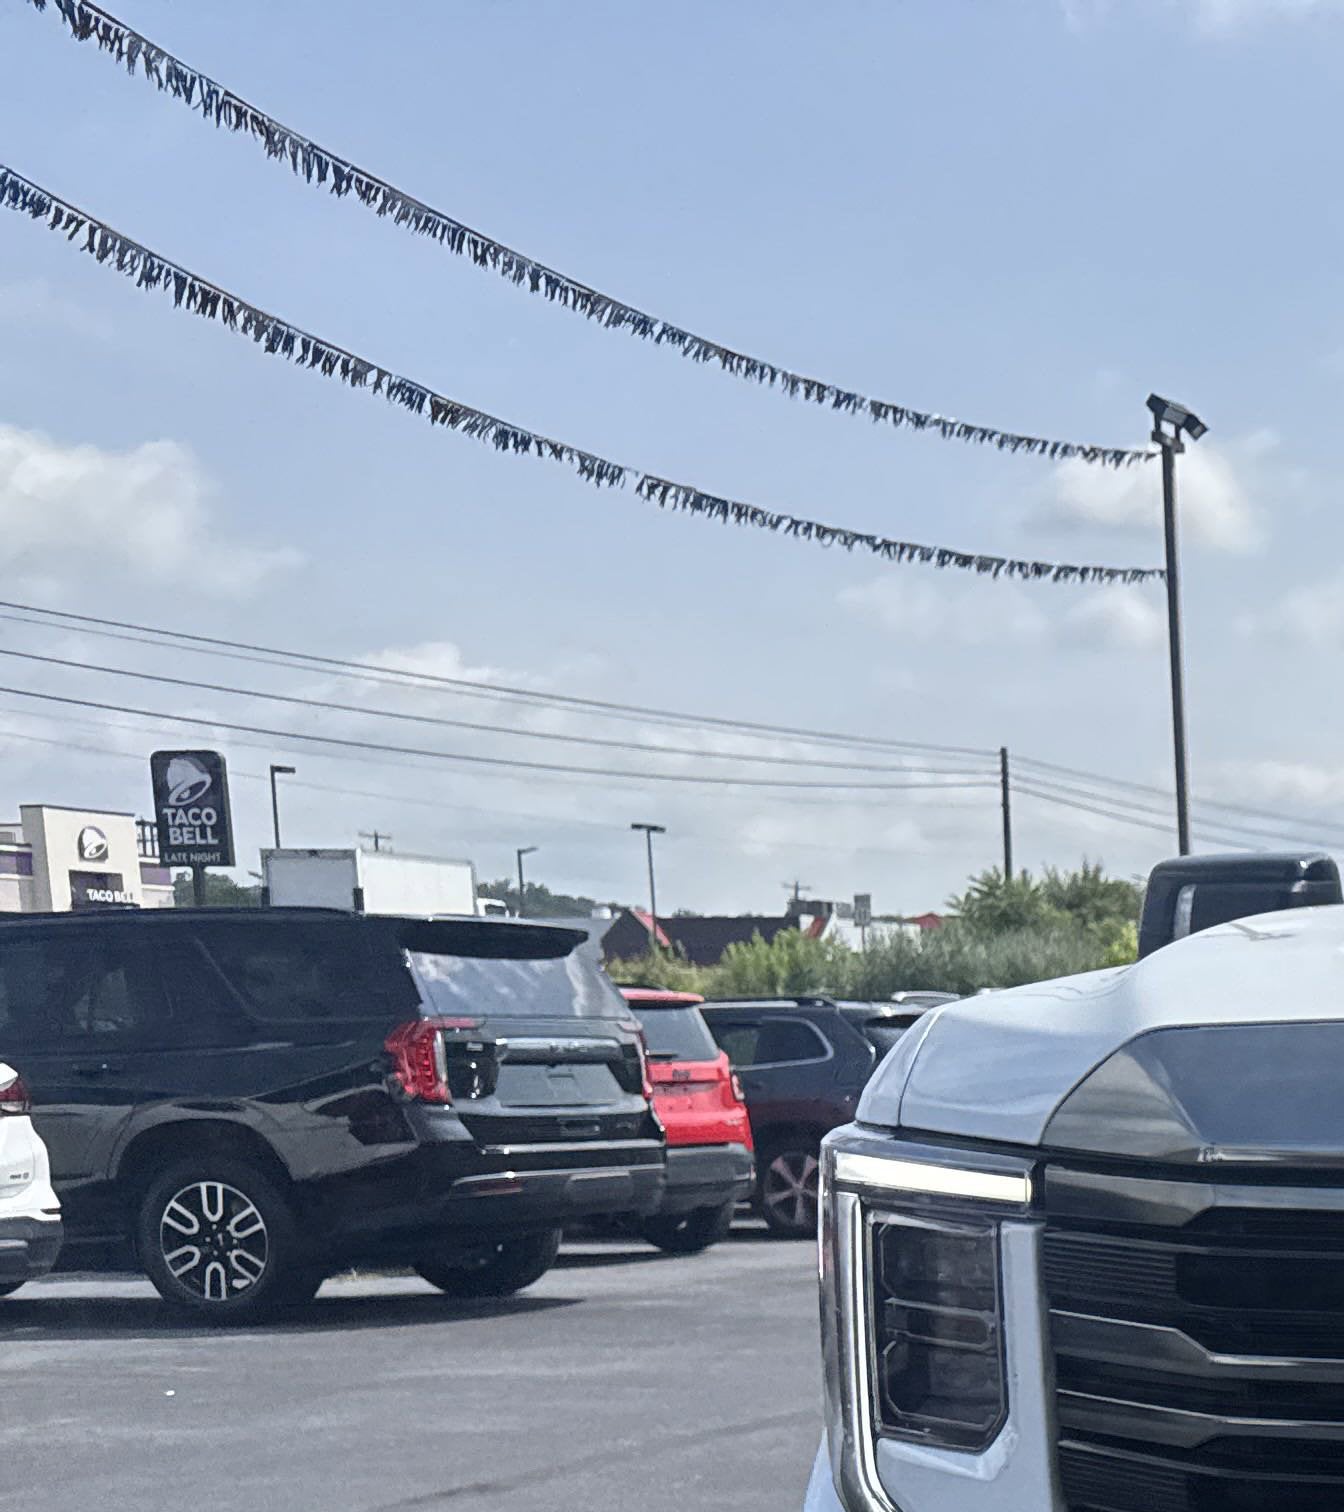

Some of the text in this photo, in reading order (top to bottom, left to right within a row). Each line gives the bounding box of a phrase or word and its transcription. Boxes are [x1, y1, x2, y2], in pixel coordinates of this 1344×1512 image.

[162, 807, 217, 826] TACO
[168, 826, 218, 845] BELL
[163, 852, 222, 863] LATE NIGHT
[86, 888, 114, 902] TACO
